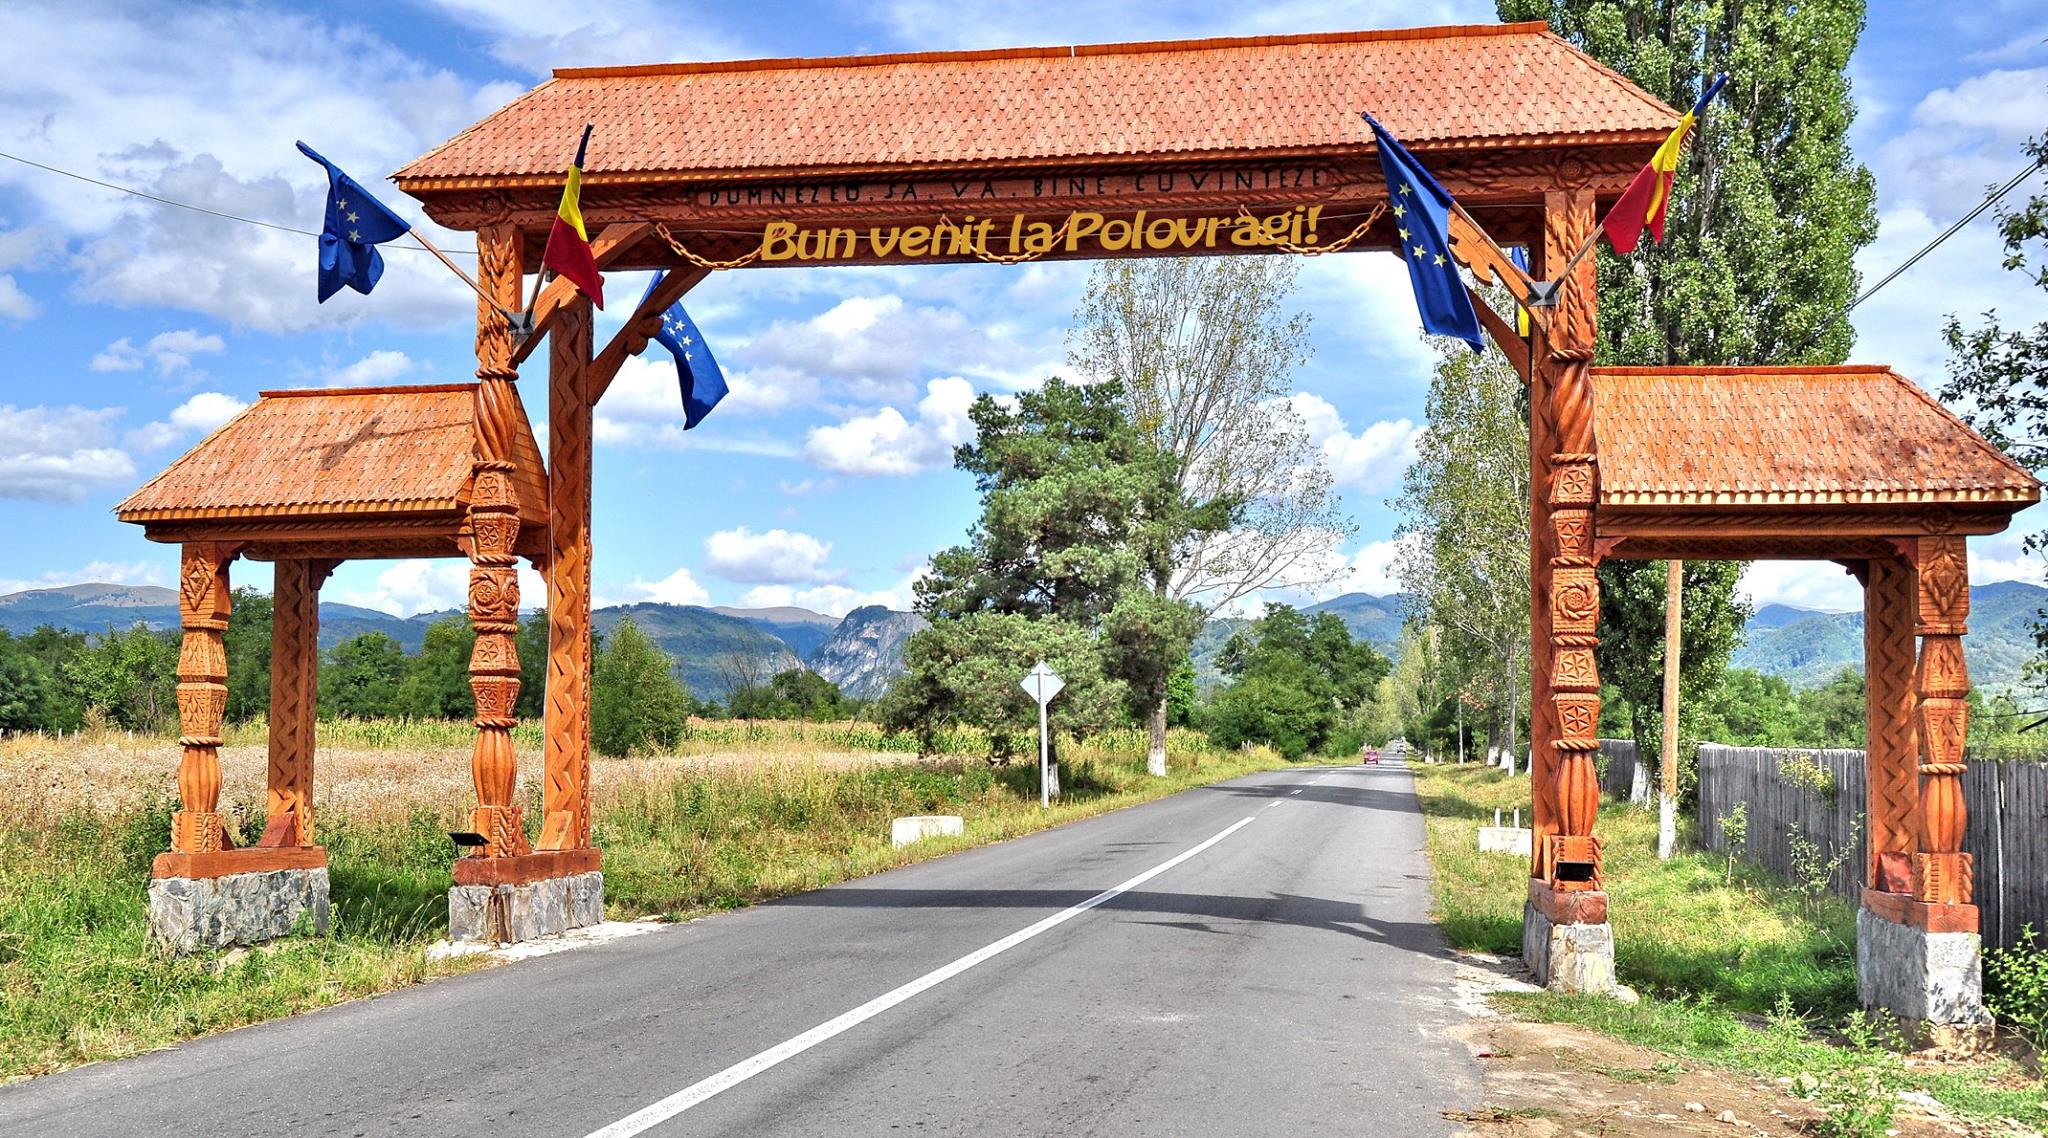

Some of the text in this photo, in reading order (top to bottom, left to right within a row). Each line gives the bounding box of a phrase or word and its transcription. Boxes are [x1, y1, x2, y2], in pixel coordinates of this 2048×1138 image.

[1136, 168, 1320, 193] CUVINTEZE
[761, 204, 1323, 261] Bun venit la Polovragi!
